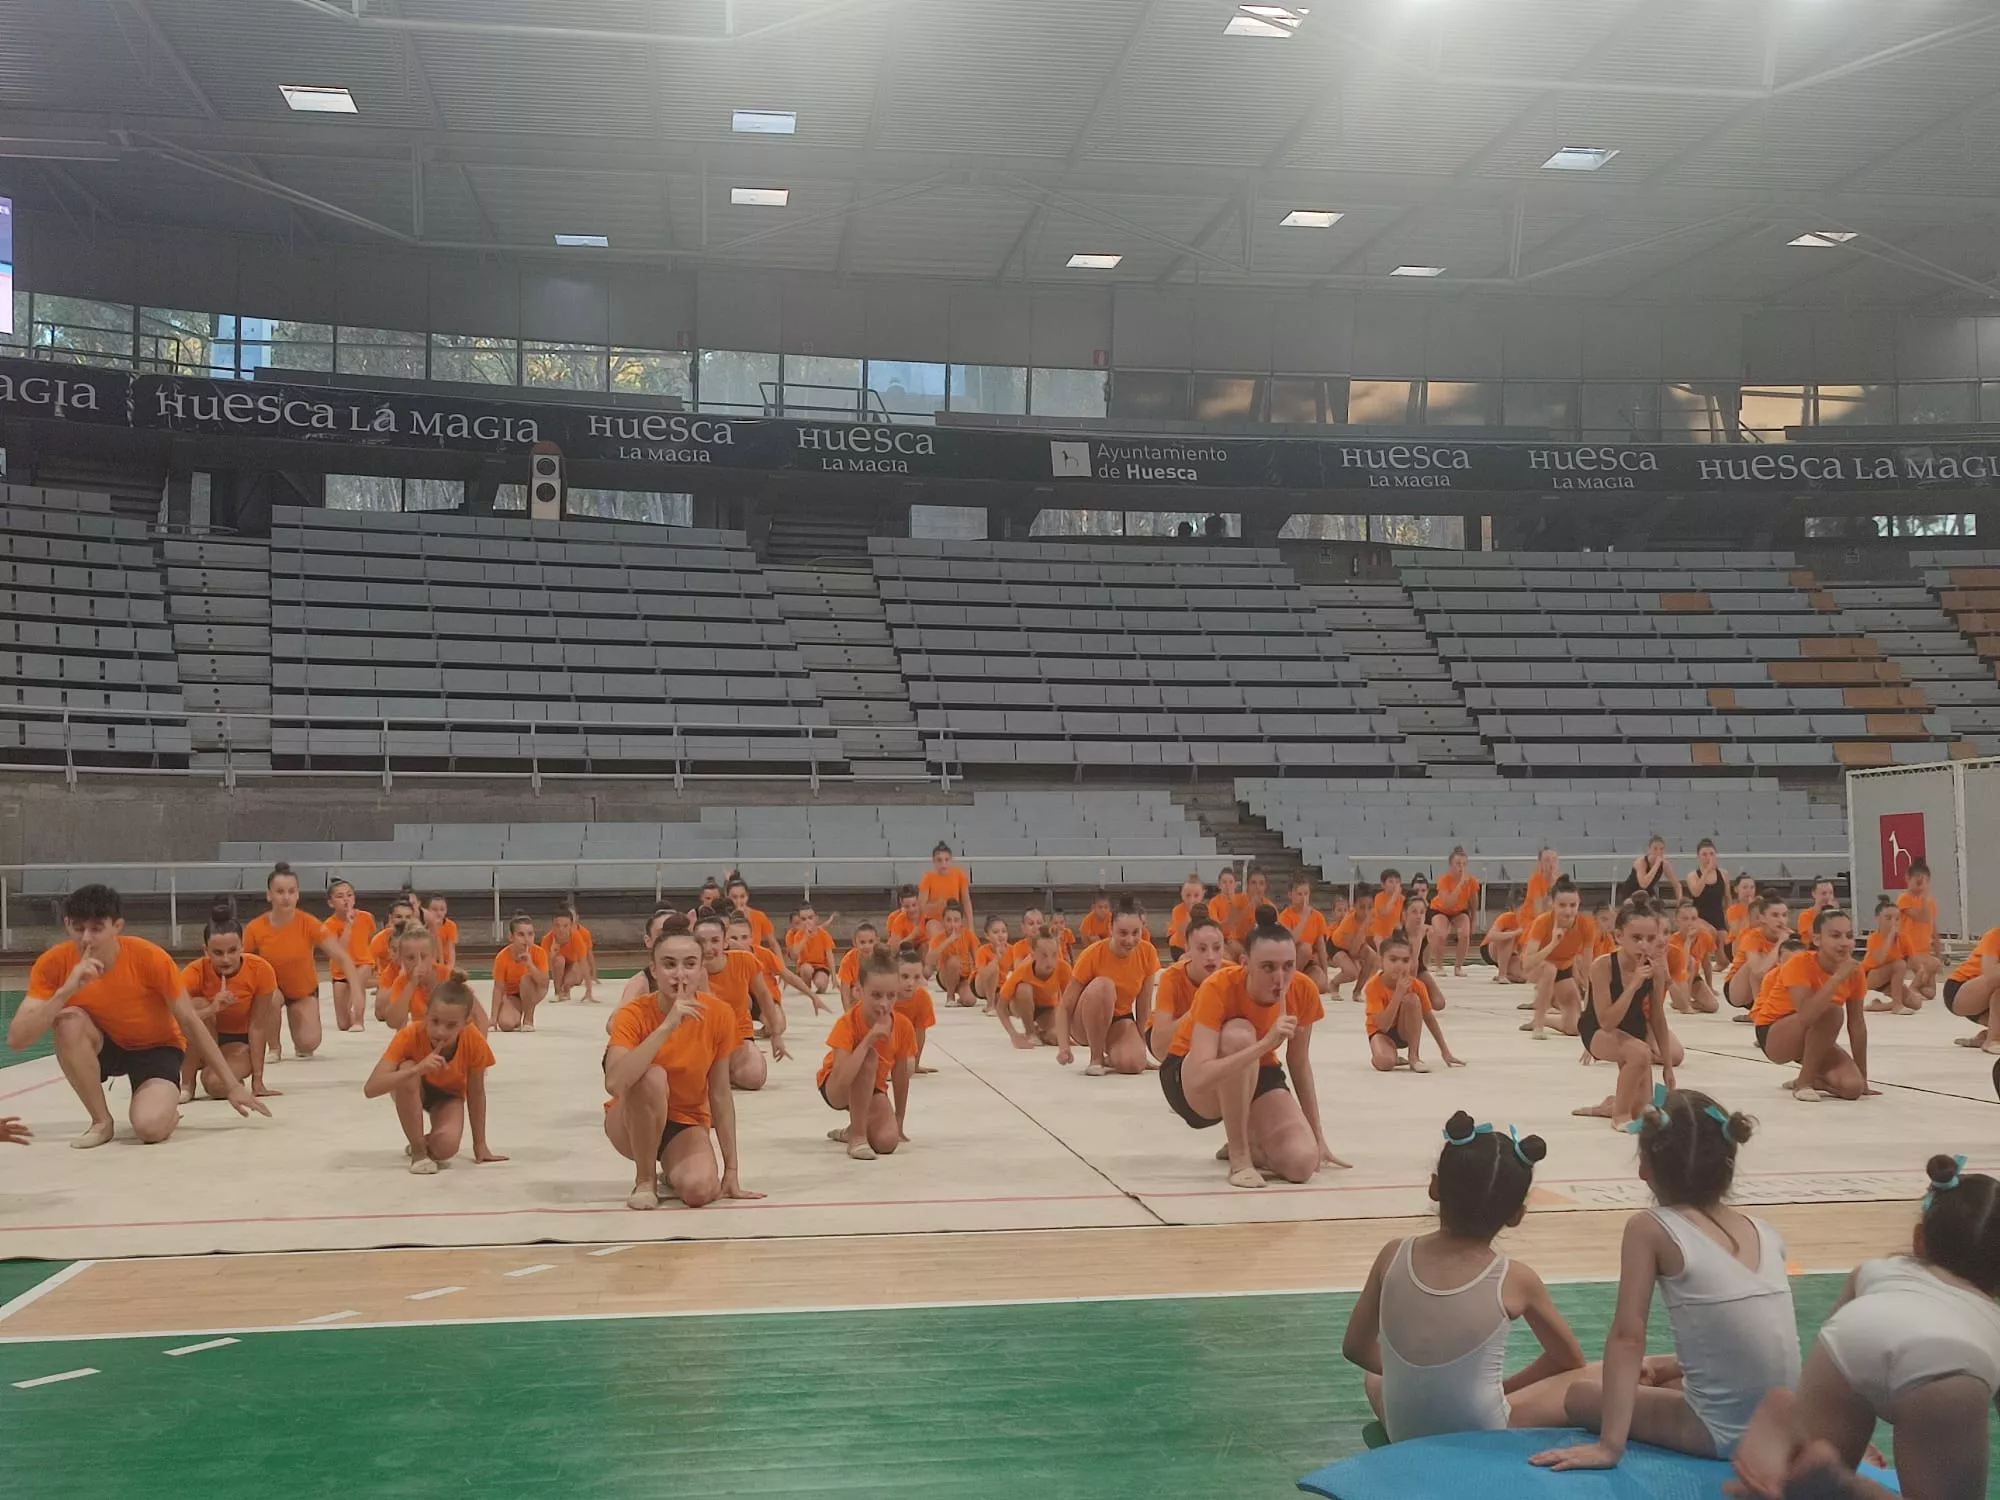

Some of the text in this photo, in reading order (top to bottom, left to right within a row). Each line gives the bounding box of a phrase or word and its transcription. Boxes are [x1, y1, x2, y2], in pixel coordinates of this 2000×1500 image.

[1096, 443, 1228, 463] Ayuntamiento
[1098, 463, 1198, 481] de Huesca
